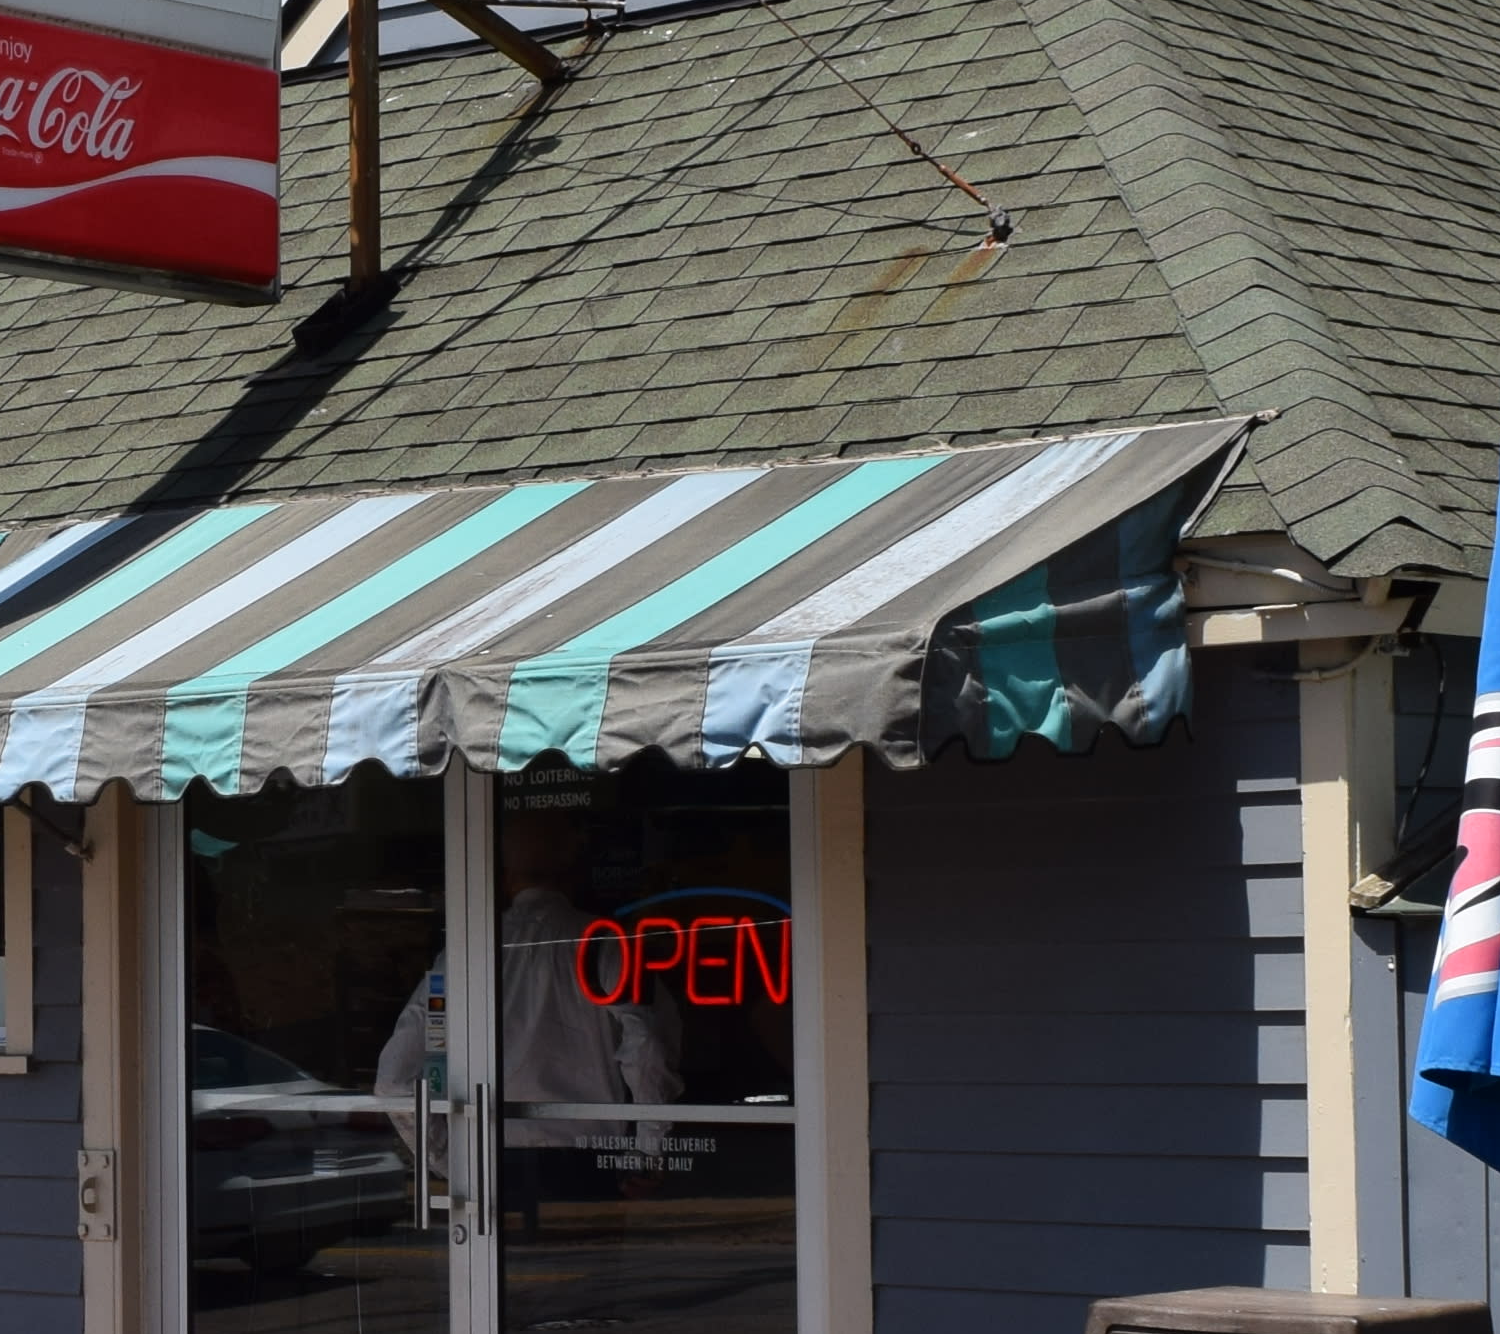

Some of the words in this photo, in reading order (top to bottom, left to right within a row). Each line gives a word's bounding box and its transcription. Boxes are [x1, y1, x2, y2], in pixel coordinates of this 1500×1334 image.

[530, 768, 595, 785] LOITERI
[504, 797, 520, 811] NO
[525, 792, 592, 809] TRESPASSING
[576, 916, 791, 1006] OPEN
[662, 1137, 717, 1153] DELIVERIES
[596, 1154, 642, 1169] BETWEEN
[668, 1157, 694, 1172] DAILY
